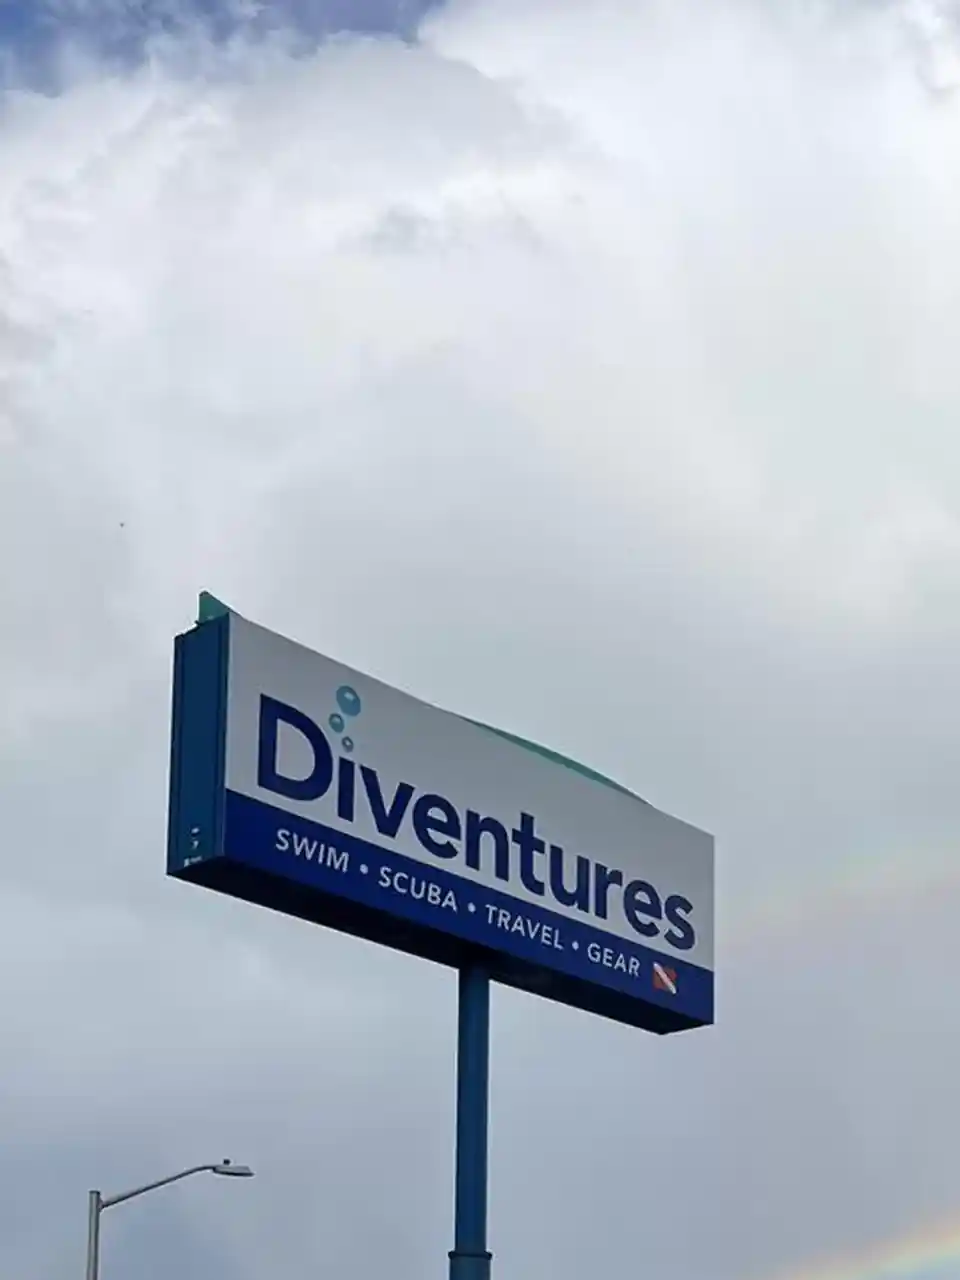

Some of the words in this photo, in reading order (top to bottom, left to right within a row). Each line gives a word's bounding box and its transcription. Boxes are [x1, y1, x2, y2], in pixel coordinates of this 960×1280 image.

[257, 688, 696, 951] Diventures
[275, 828, 350, 873] SWIM
[378, 866, 459, 914] SCUBA
[485, 903, 565, 950] TRAVEL
[587, 943, 641, 977] GEAR
